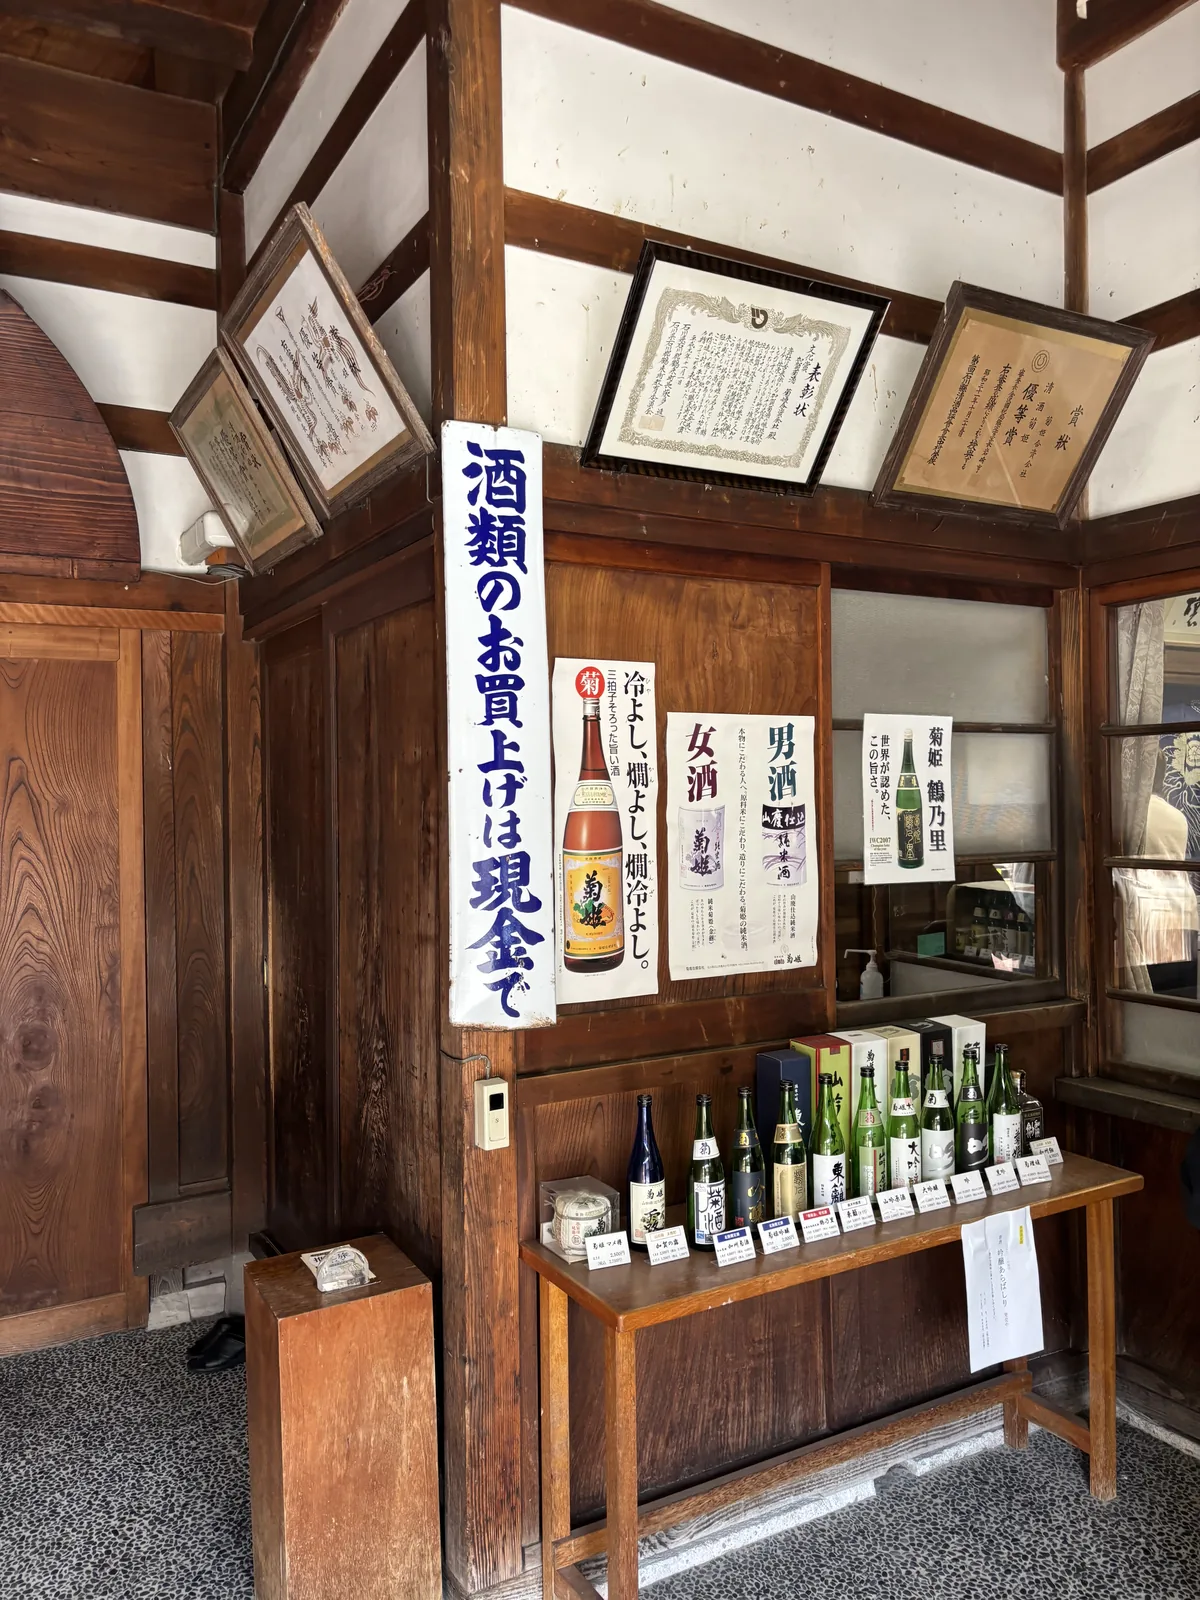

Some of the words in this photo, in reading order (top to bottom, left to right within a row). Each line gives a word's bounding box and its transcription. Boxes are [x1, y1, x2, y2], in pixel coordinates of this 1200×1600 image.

[792, 362, 822, 418] 表彰状
[1002, 382, 1039, 446] 優等賞
[580, 671, 600, 696] 菊
[463, 440, 544, 1018] 酒類のお買上げは現金で
[607, 669, 620, 777] 三拍子そろった旨い酒
[928, 726, 944, 768] 菊姫
[685, 722, 718, 803] 女酒
[766, 722, 797, 802] 男酒
[869, 736, 880, 794] この旨さ。
[880, 734, 891, 820] 世界が認めた、
[623, 670, 650, 970] 冷よし、燗よし、燗冷よし。
[738, 727, 748, 952] 本物にこだわる人へ。原料米にこだわり、造りにこだわる。菊姫の純米酒。
[927, 780, 946, 852] 鶴乃里
[691, 828, 712, 876] 菊姫
[580, 870, 607, 930] 菊姫
[700, 1142, 711, 1156] 菊
